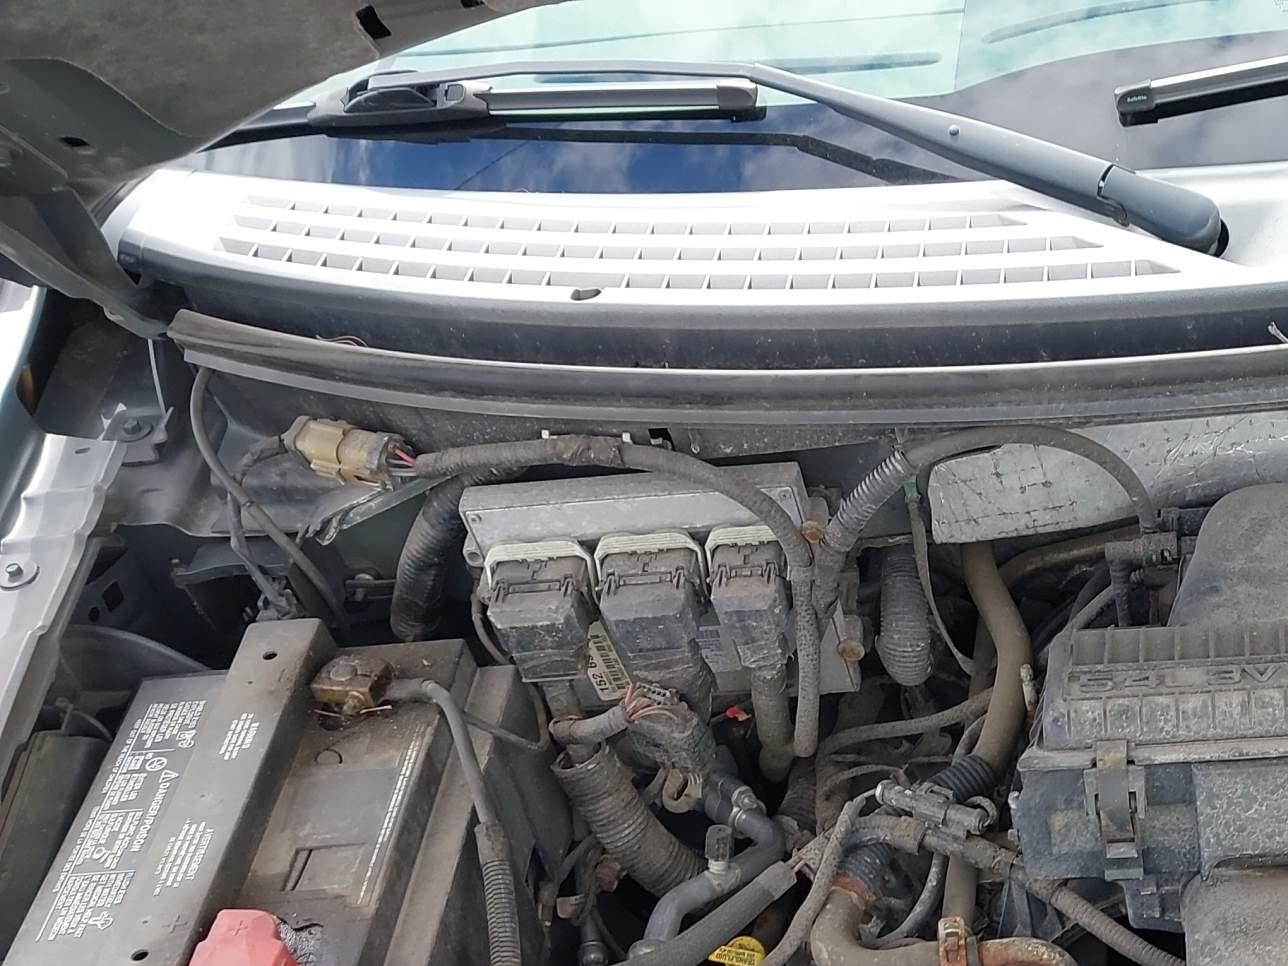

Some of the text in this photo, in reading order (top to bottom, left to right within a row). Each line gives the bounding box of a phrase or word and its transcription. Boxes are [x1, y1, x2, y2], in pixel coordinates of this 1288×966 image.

[592, 672, 609, 691] 152
[1207, 664, 1283, 686] 3V
[129, 782, 170, 852] DANGER/POISON
